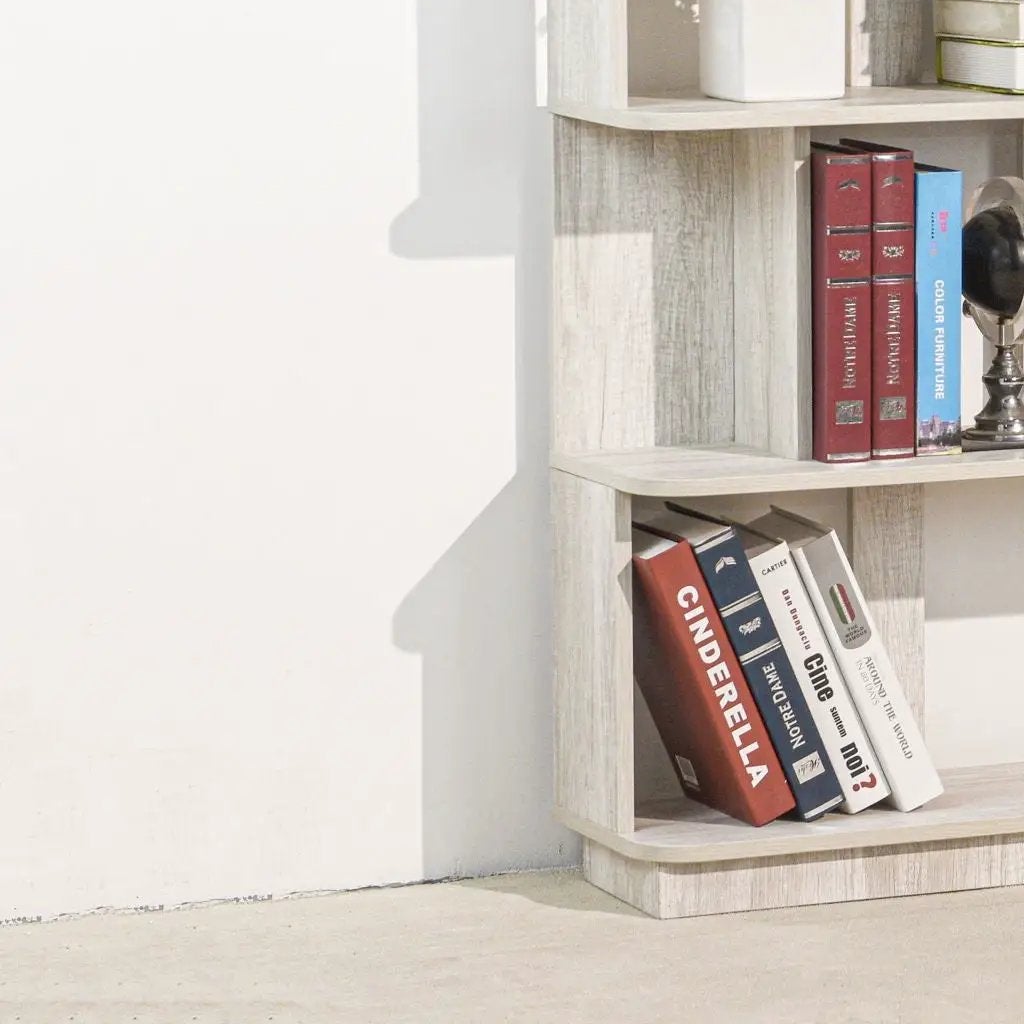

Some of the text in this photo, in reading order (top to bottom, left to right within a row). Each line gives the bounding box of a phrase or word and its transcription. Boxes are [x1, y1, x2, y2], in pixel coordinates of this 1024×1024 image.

[934, 279, 945, 400] COLOR FURNITURE
[761, 558, 788, 576] CARTIER
[677, 584, 770, 788] CINDERELLA
[762, 662, 806, 750] NOTRE DAME
[782, 588, 794, 607] Dan
[803, 652, 834, 703] Cine
[829, 706, 848, 738] suntem
[864, 656, 914, 759] AROUND THE WORLD
